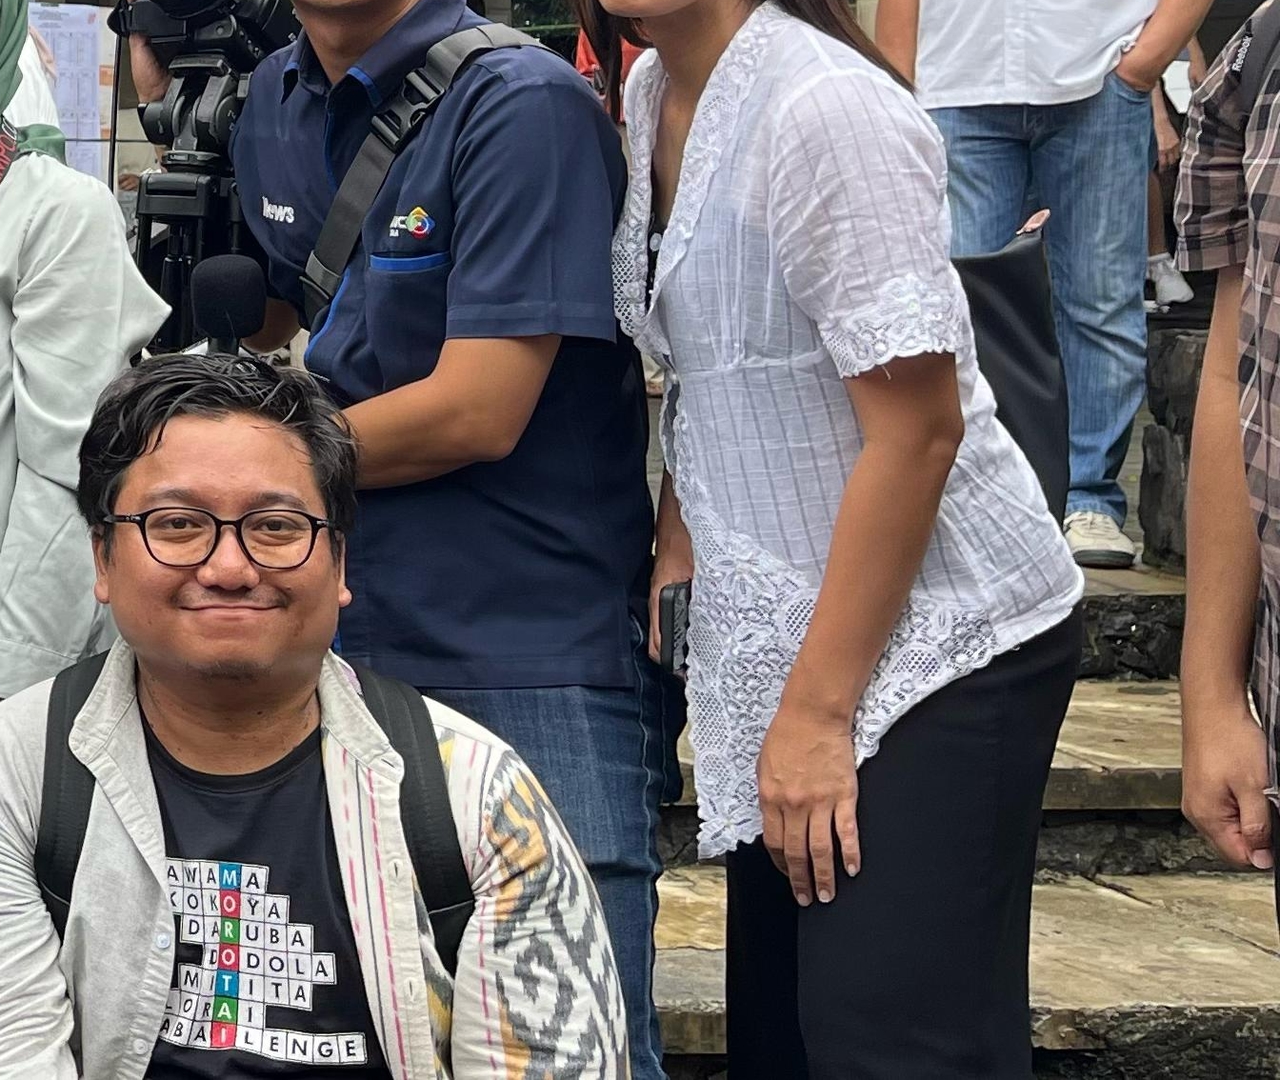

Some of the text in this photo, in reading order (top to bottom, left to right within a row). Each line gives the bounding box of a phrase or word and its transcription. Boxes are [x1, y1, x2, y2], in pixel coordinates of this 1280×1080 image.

[1231, 35, 1252, 72] Reebok
[189, 921, 305, 947] DARUBA
[209, 948, 328, 977] DODOLA
[184, 971, 306, 1002] MITITA
[167, 999, 252, 1022] ORAI
